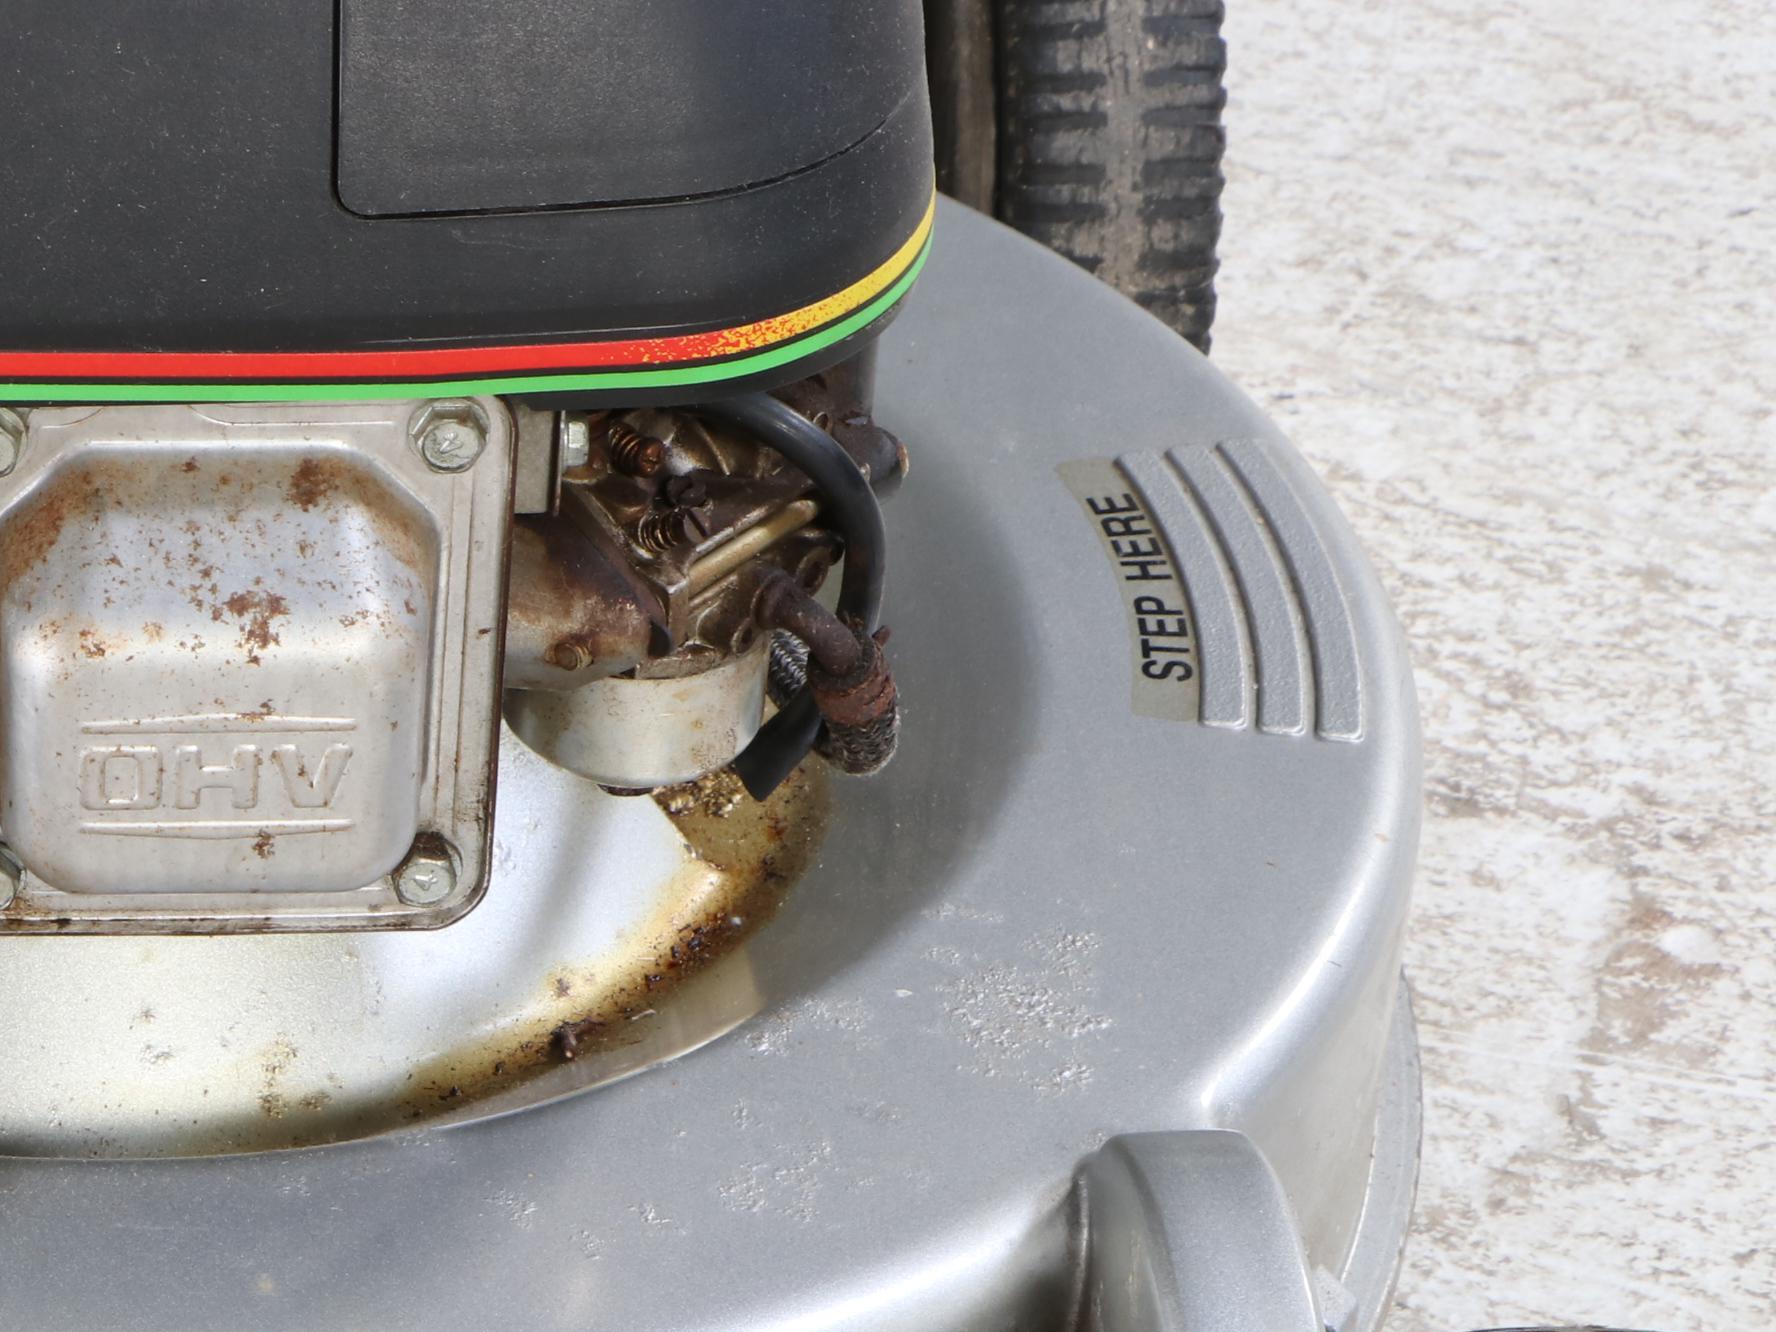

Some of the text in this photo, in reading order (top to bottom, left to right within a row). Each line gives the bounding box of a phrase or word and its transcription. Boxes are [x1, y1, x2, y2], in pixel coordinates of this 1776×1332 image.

[1085, 492, 1194, 683] STEP HERE
[79, 743, 355, 811] OHV
